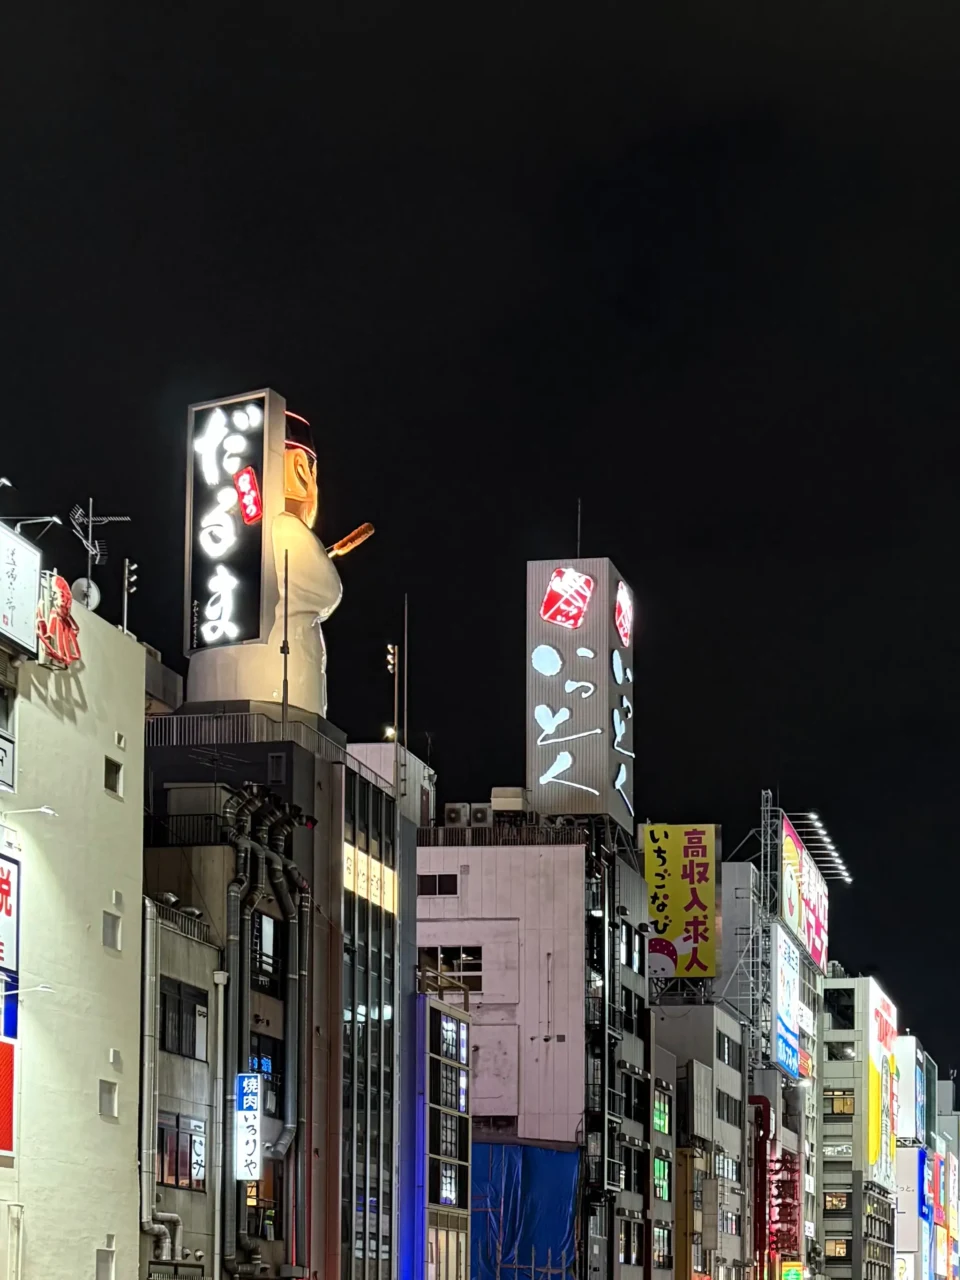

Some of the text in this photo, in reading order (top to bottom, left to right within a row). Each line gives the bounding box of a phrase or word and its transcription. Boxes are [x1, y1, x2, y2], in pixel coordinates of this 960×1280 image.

[194, 403, 263, 643] だるま
[649, 829, 673, 935] いちごなび
[681, 828, 710, 973] 高収入求人
[242, 1077, 259, 1177] 焼肉 いろりや
